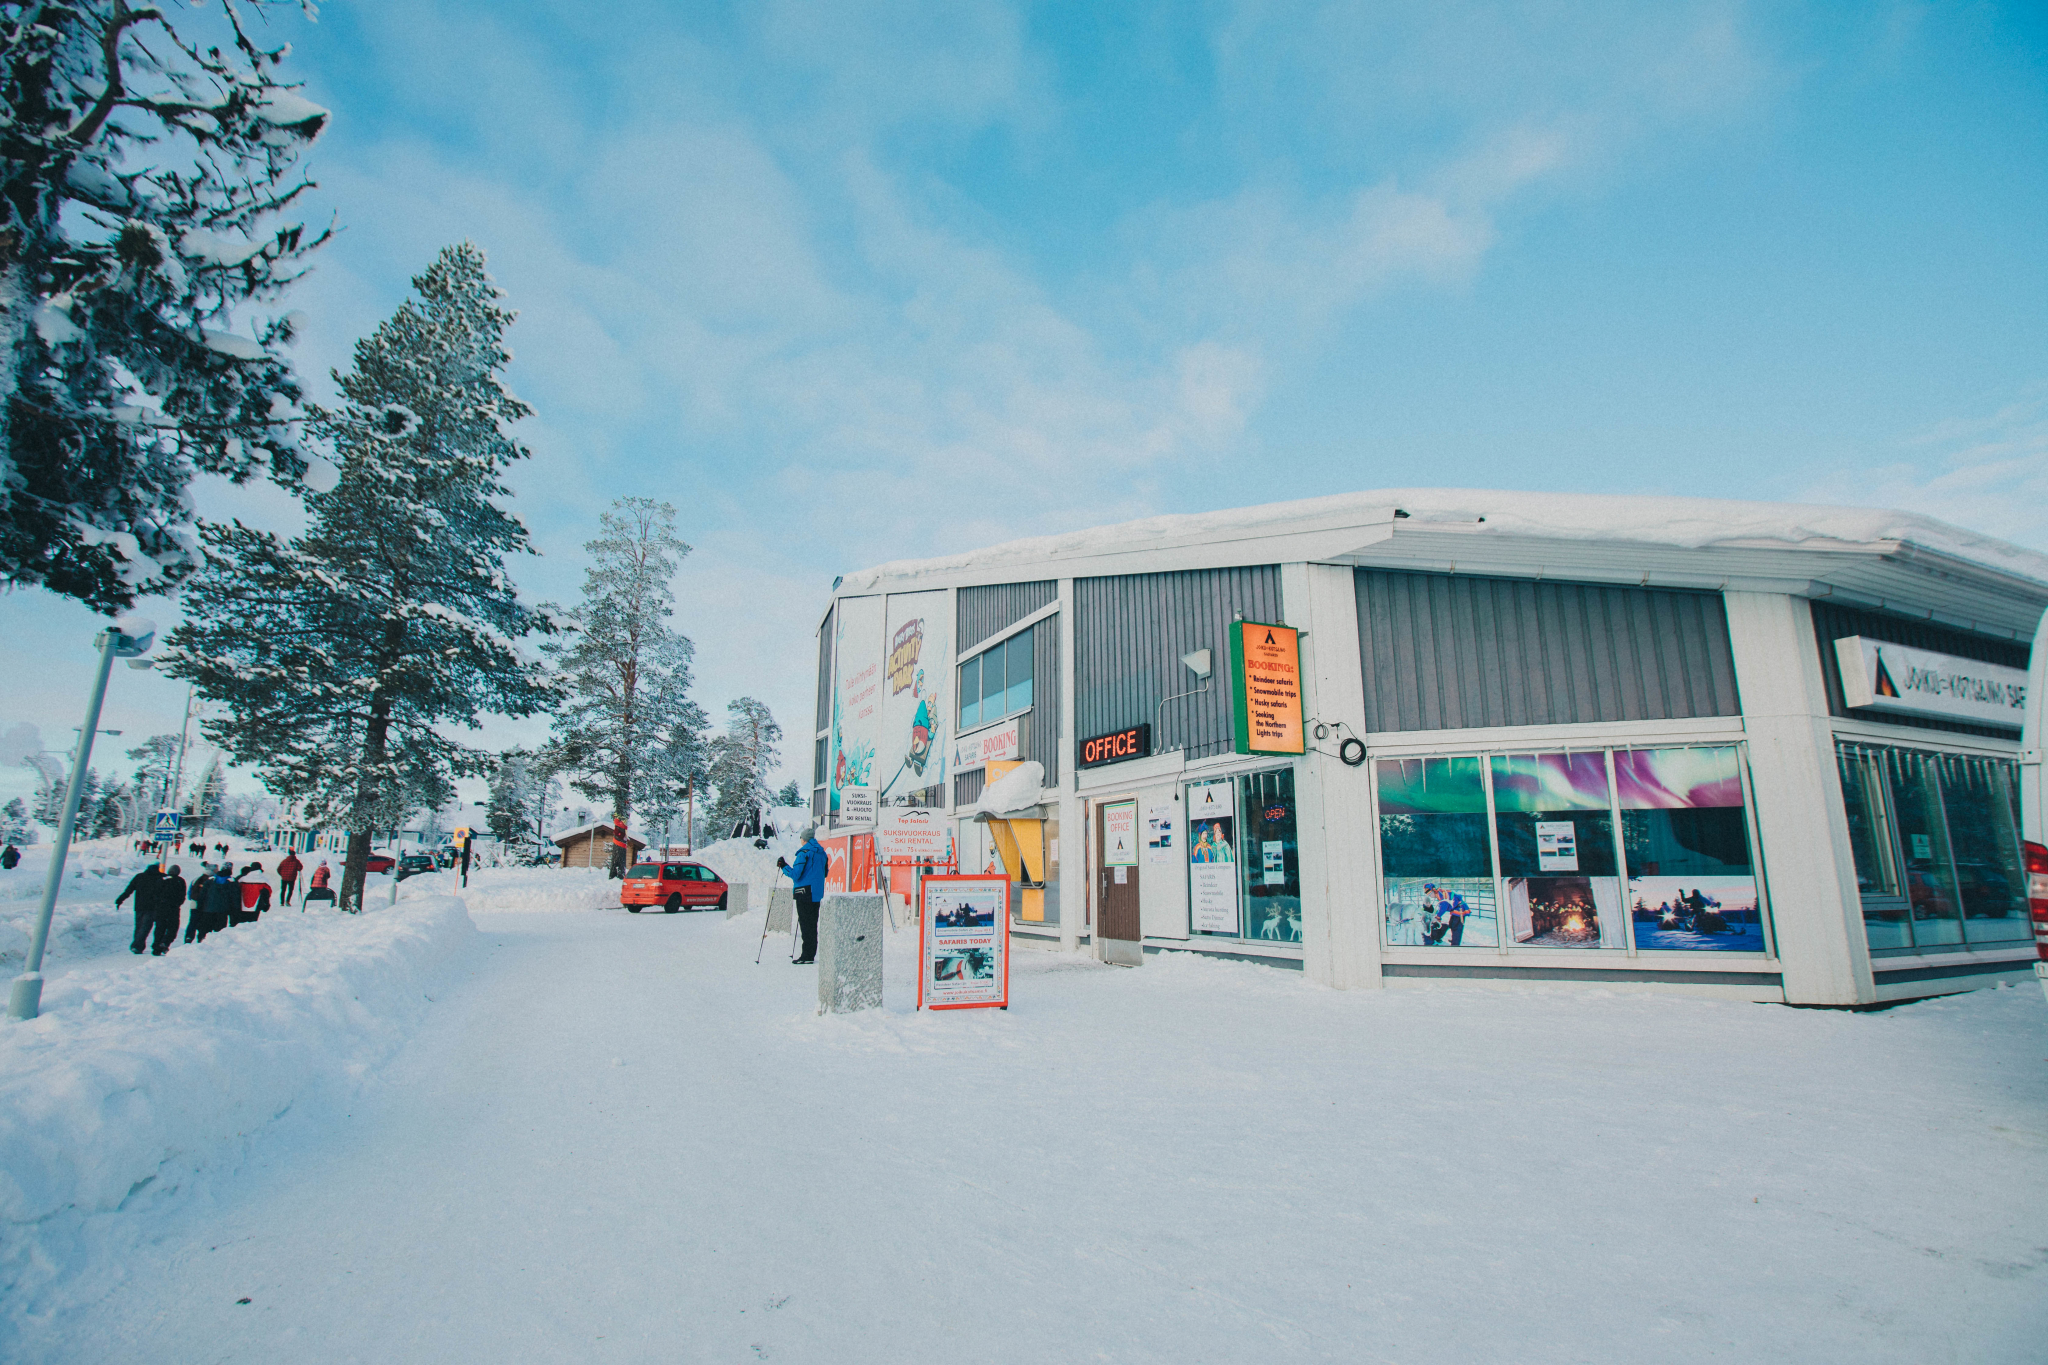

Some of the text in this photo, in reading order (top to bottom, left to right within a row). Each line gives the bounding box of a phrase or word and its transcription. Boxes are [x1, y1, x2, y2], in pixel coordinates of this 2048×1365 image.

[888, 635, 922, 678] ACTIVITY
[1248, 659, 1294, 673] BOOKING:
[893, 662, 914, 695] PARK
[1253, 674, 1293, 686] Reindeer safaris
[1253, 686, 1296, 699] Snowmobile trips
[1254, 698, 1287, 708] Husky safaris
[1255, 710, 1274, 720] Seeking
[1256, 719, 1287, 728] the Northern
[1256, 728, 1283, 739] Lights trips
[983, 729, 1017, 755] BOOKING
[1085, 730, 1137, 762] OFFICE
[1107, 810, 1133, 822] BOOKING
[1264, 807, 1286, 820] OPEN
[898, 817, 909, 825] Top
[883, 829, 941, 837] SUKSIVUOKRAUS
[1110, 822, 1130, 833] OFFICE
[907, 837, 934, 845] RENTAL
